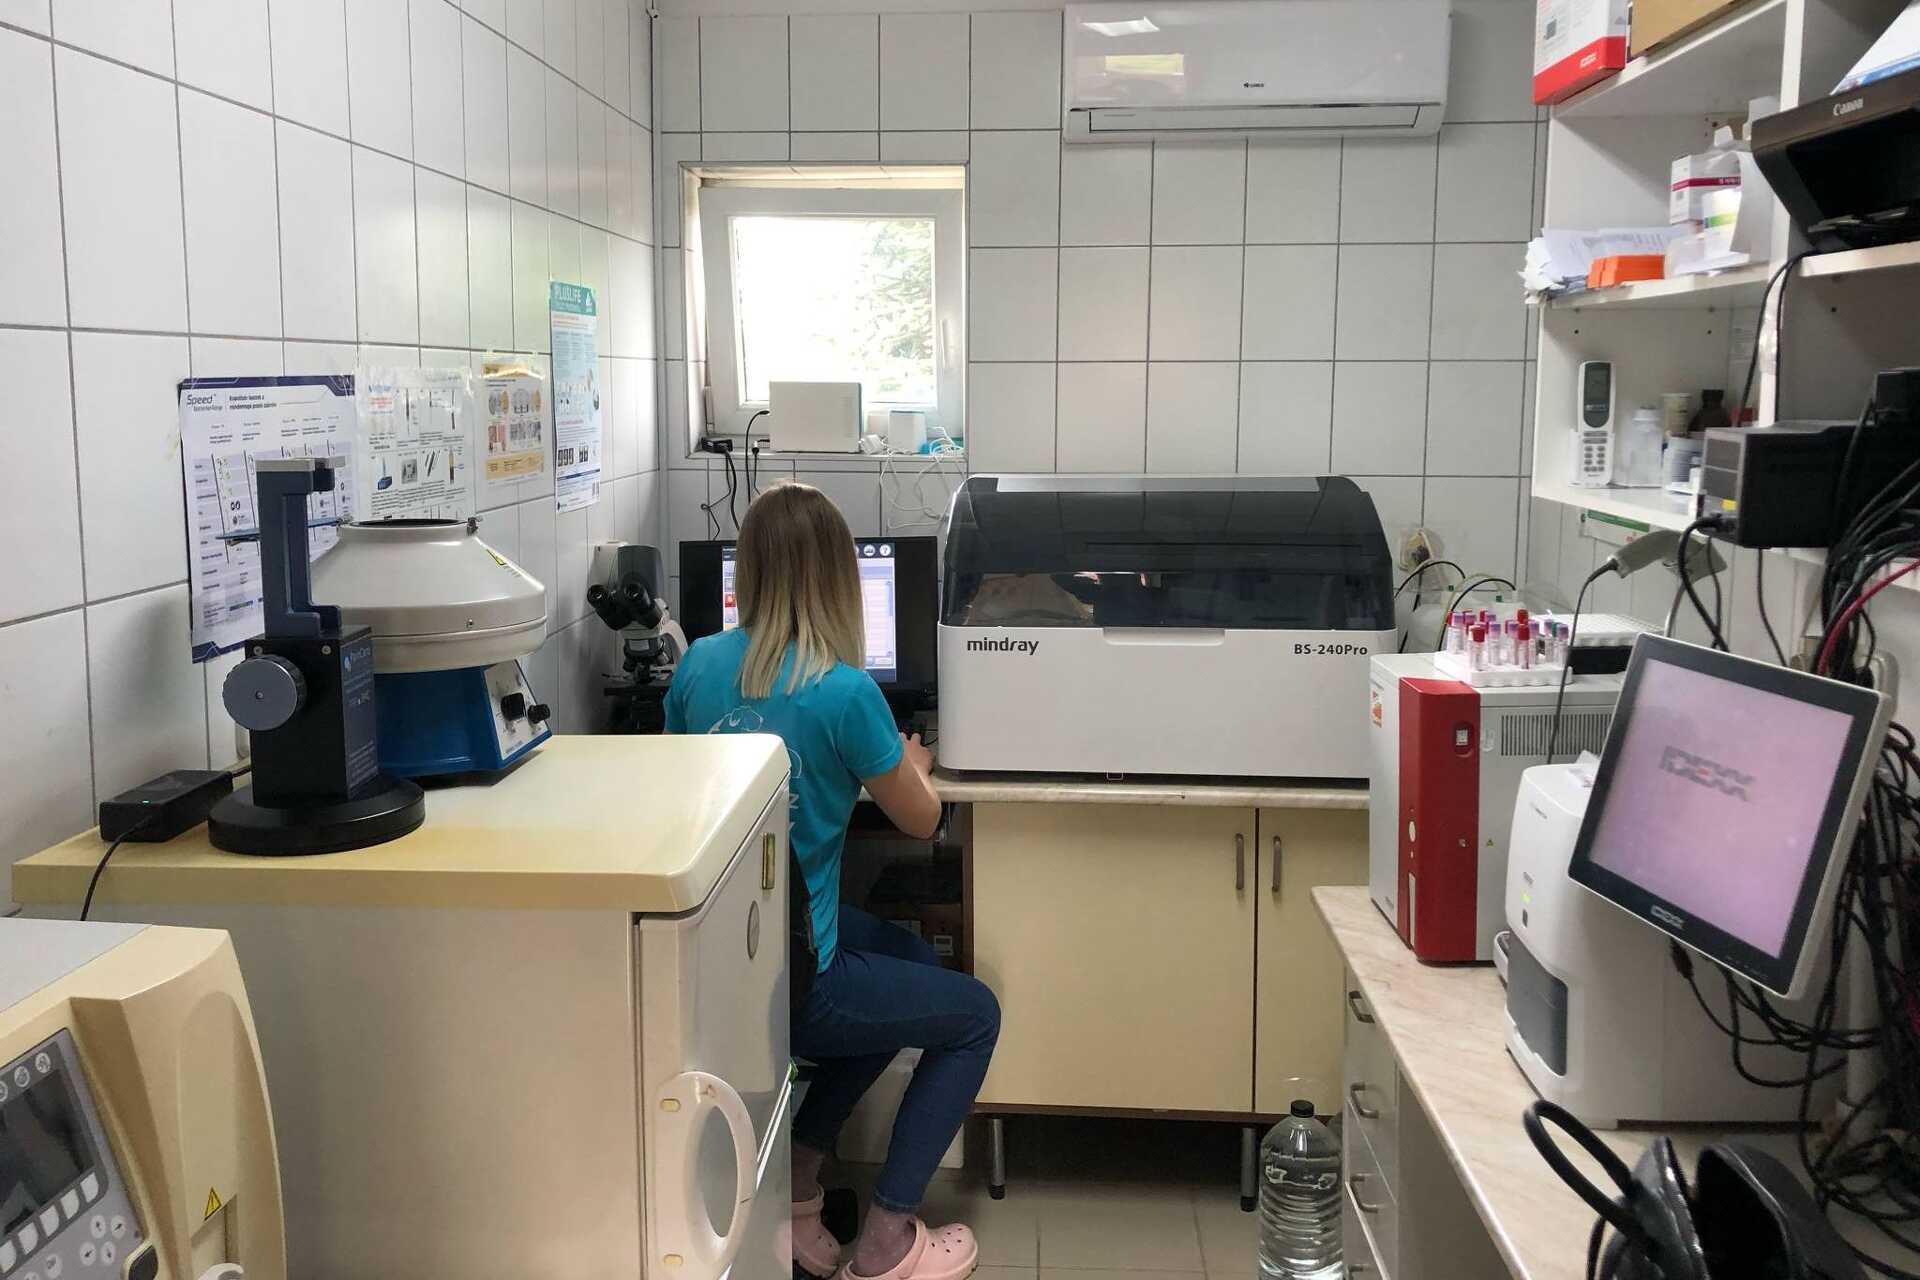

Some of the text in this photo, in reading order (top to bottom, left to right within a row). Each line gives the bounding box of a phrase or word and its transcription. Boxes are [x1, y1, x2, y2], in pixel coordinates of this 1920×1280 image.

[1833, 98, 1863, 115] Canon
[187, 394, 213, 406] Speed
[967, 637, 1039, 655] mindray
[1294, 644, 1368, 655] BS-240Pro
